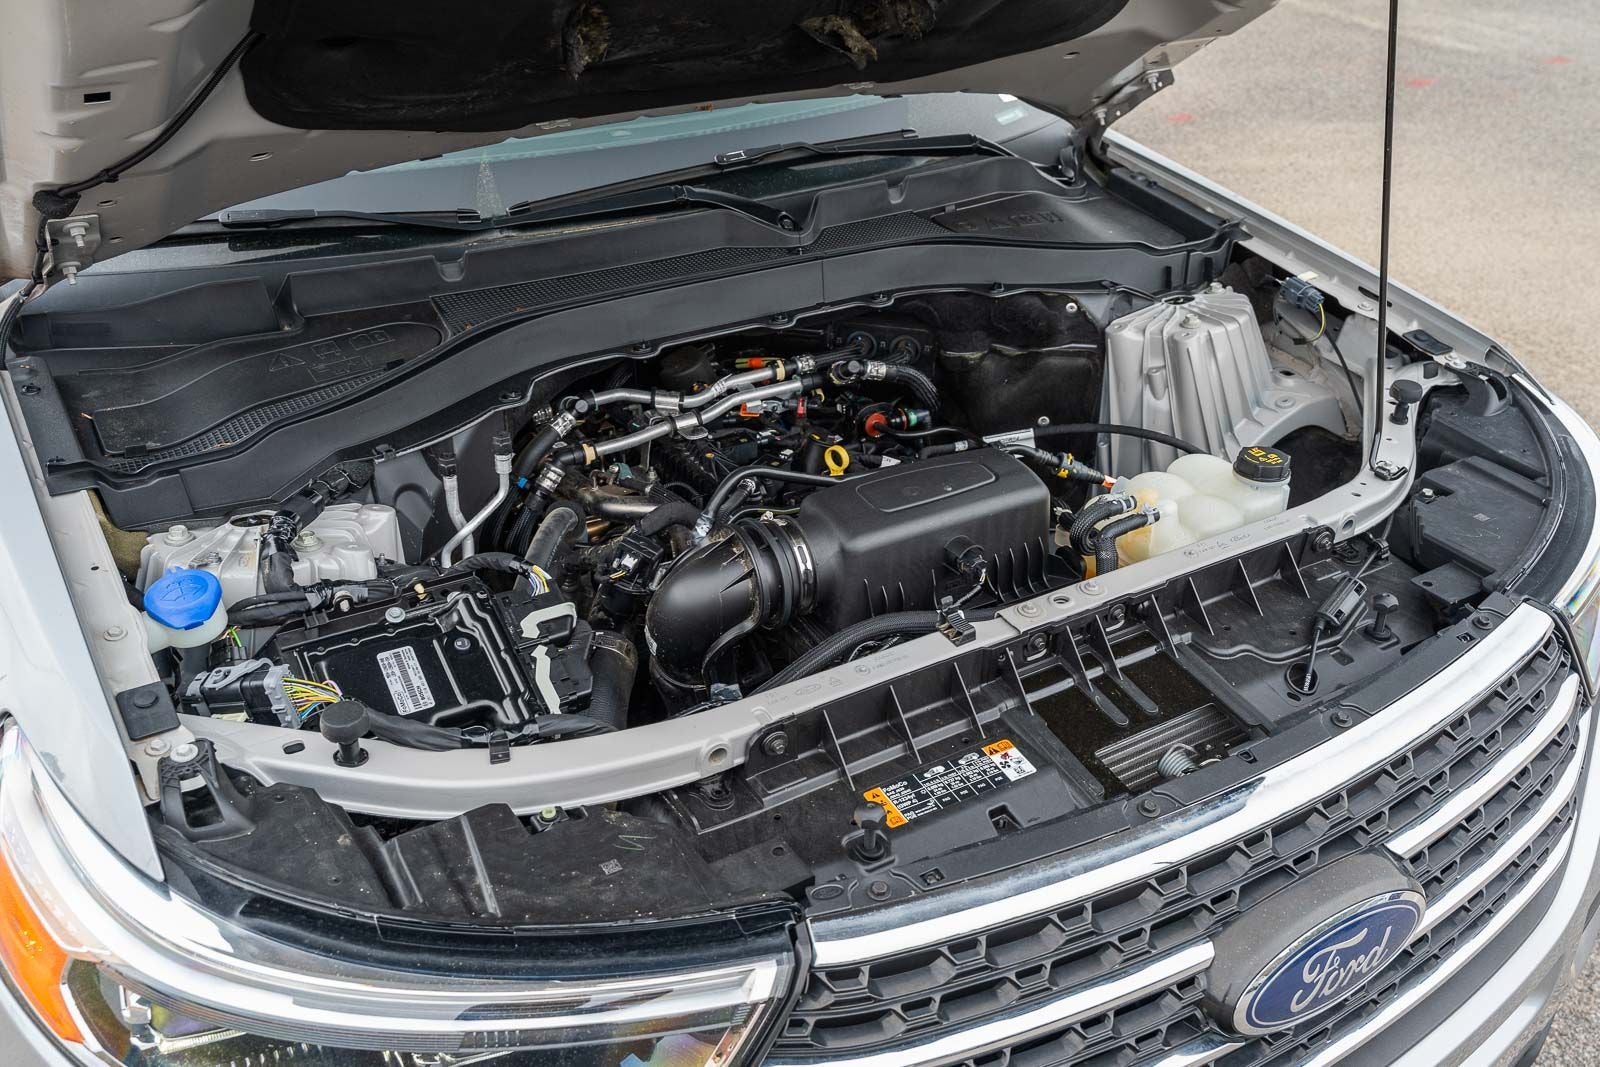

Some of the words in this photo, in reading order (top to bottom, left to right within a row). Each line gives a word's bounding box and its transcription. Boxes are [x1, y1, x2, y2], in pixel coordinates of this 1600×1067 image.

[416, 685, 426, 701] BOSCH
[883, 781, 908, 792] FoMoCo
[1291, 926, 1392, 1013] Ford
